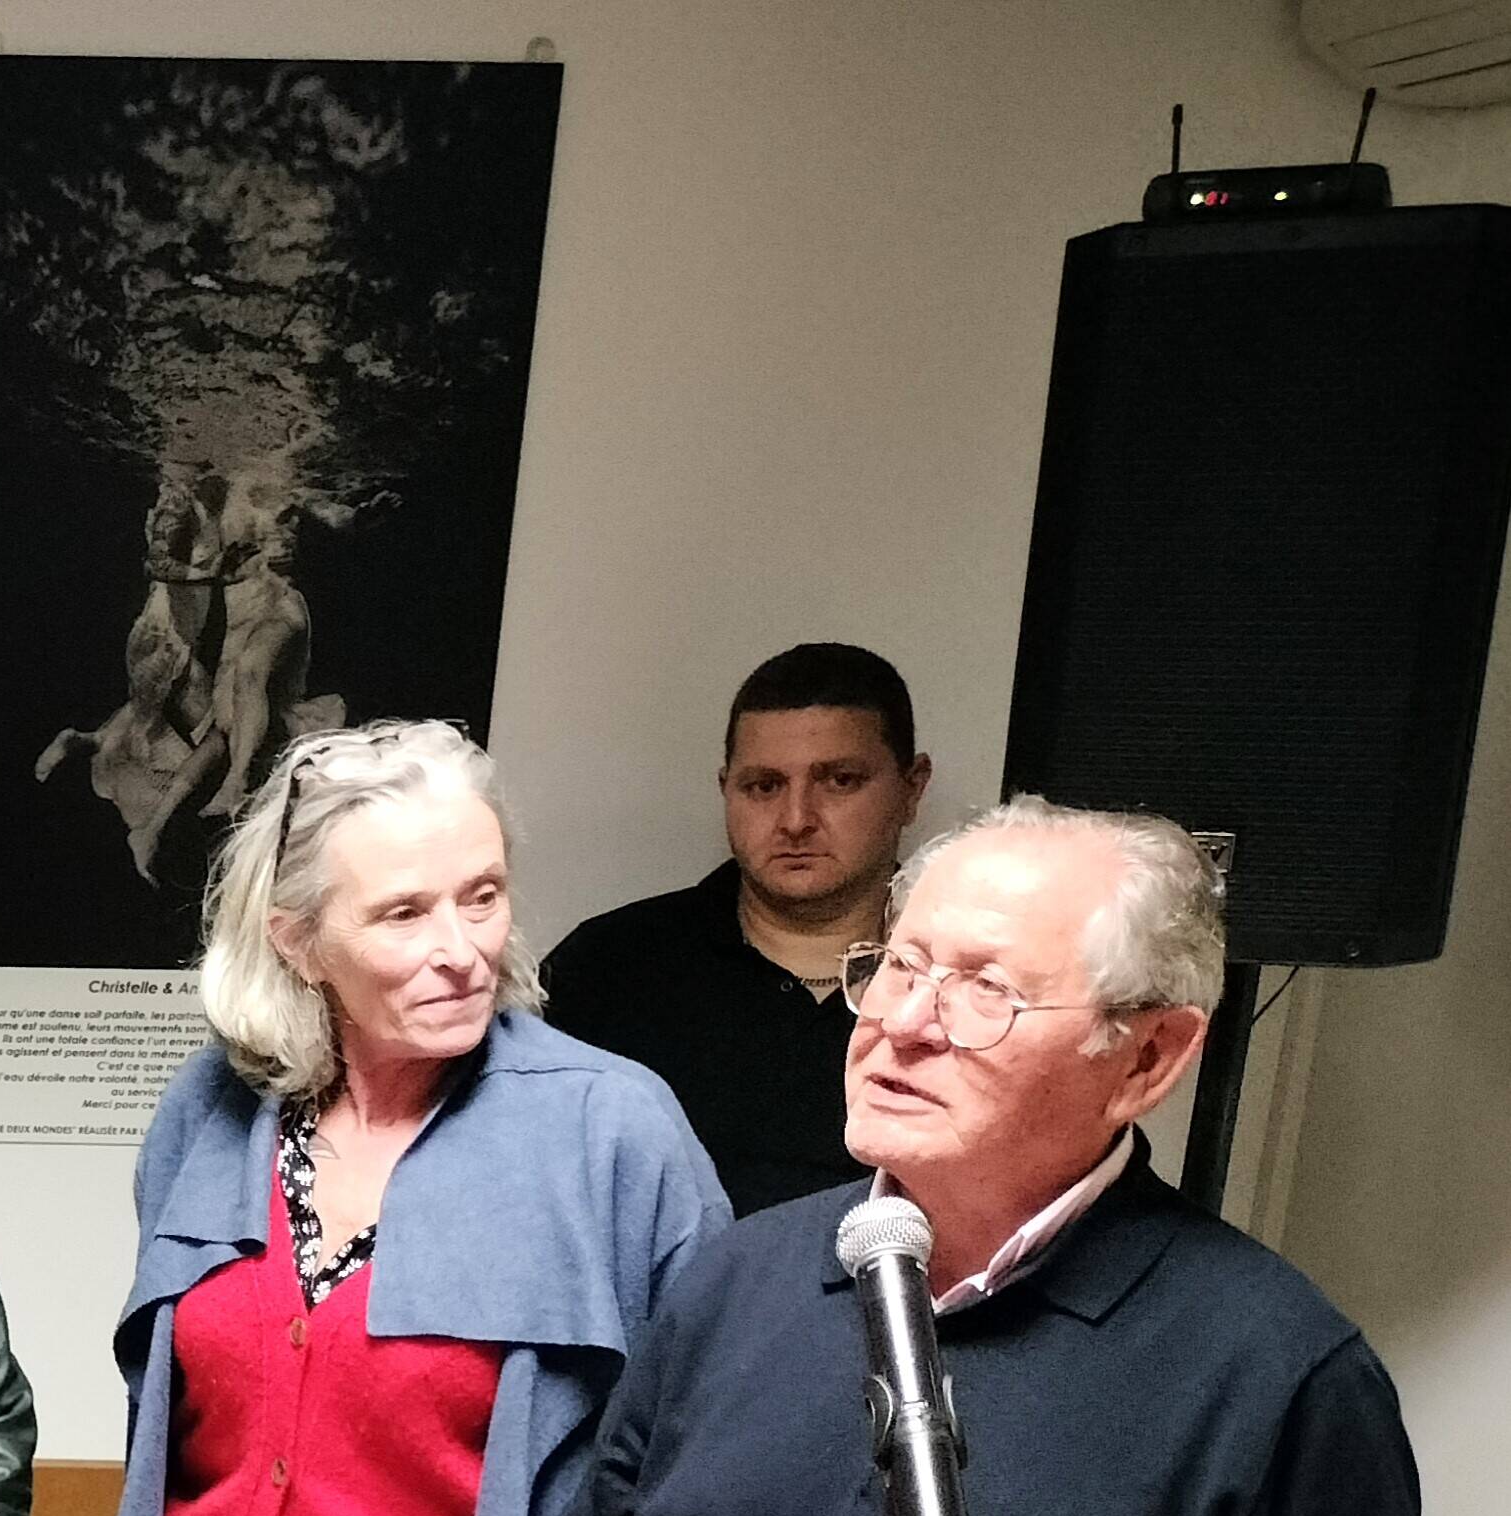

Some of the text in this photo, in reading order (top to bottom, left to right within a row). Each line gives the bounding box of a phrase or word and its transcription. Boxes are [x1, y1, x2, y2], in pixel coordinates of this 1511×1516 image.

[88, 980, 201, 995] Christelle & An
[10, 1008, 46, 1019] qu'une
[48, 1009, 81, 1019] danse
[151, 1011, 165, 1020] les
[21, 1022, 37, 1031] est
[86, 1023, 110, 1032] leurs
[113, 1024, 182, 1033] mouvements
[2, 1034, 13, 1043] Ils
[15, 1035, 33, 1044] ont
[36, 1036, 55, 1044] une
[58, 1035, 88, 1045] totale
[90, 1036, 145, 1046] confiance
[169, 1038, 204, 1047] envers
[6, 1047, 49, 1058] agissent
[51, 1048, 62, 1057] et
[64, 1048, 107, 1058] pensent
[110, 1049, 135, 1058] dans
[137, 1050, 147, 1059] la
[150, 1050, 185, 1059] même
[96, 1061, 124, 1071] C'est
[126, 1063, 140, 1071] ce
[143, 1064, 164, 1072] que
[27, 1073, 66, 1082] dévoile
[68, 1074, 95, 1083] notre
[111, 1089, 125, 1097] au
[82, 1099, 112, 1108] Merci
[114, 1101, 139, 1110] pour
[6, 1125, 30, 1134] DEUX
[119, 1126, 138, 1136] PAR
